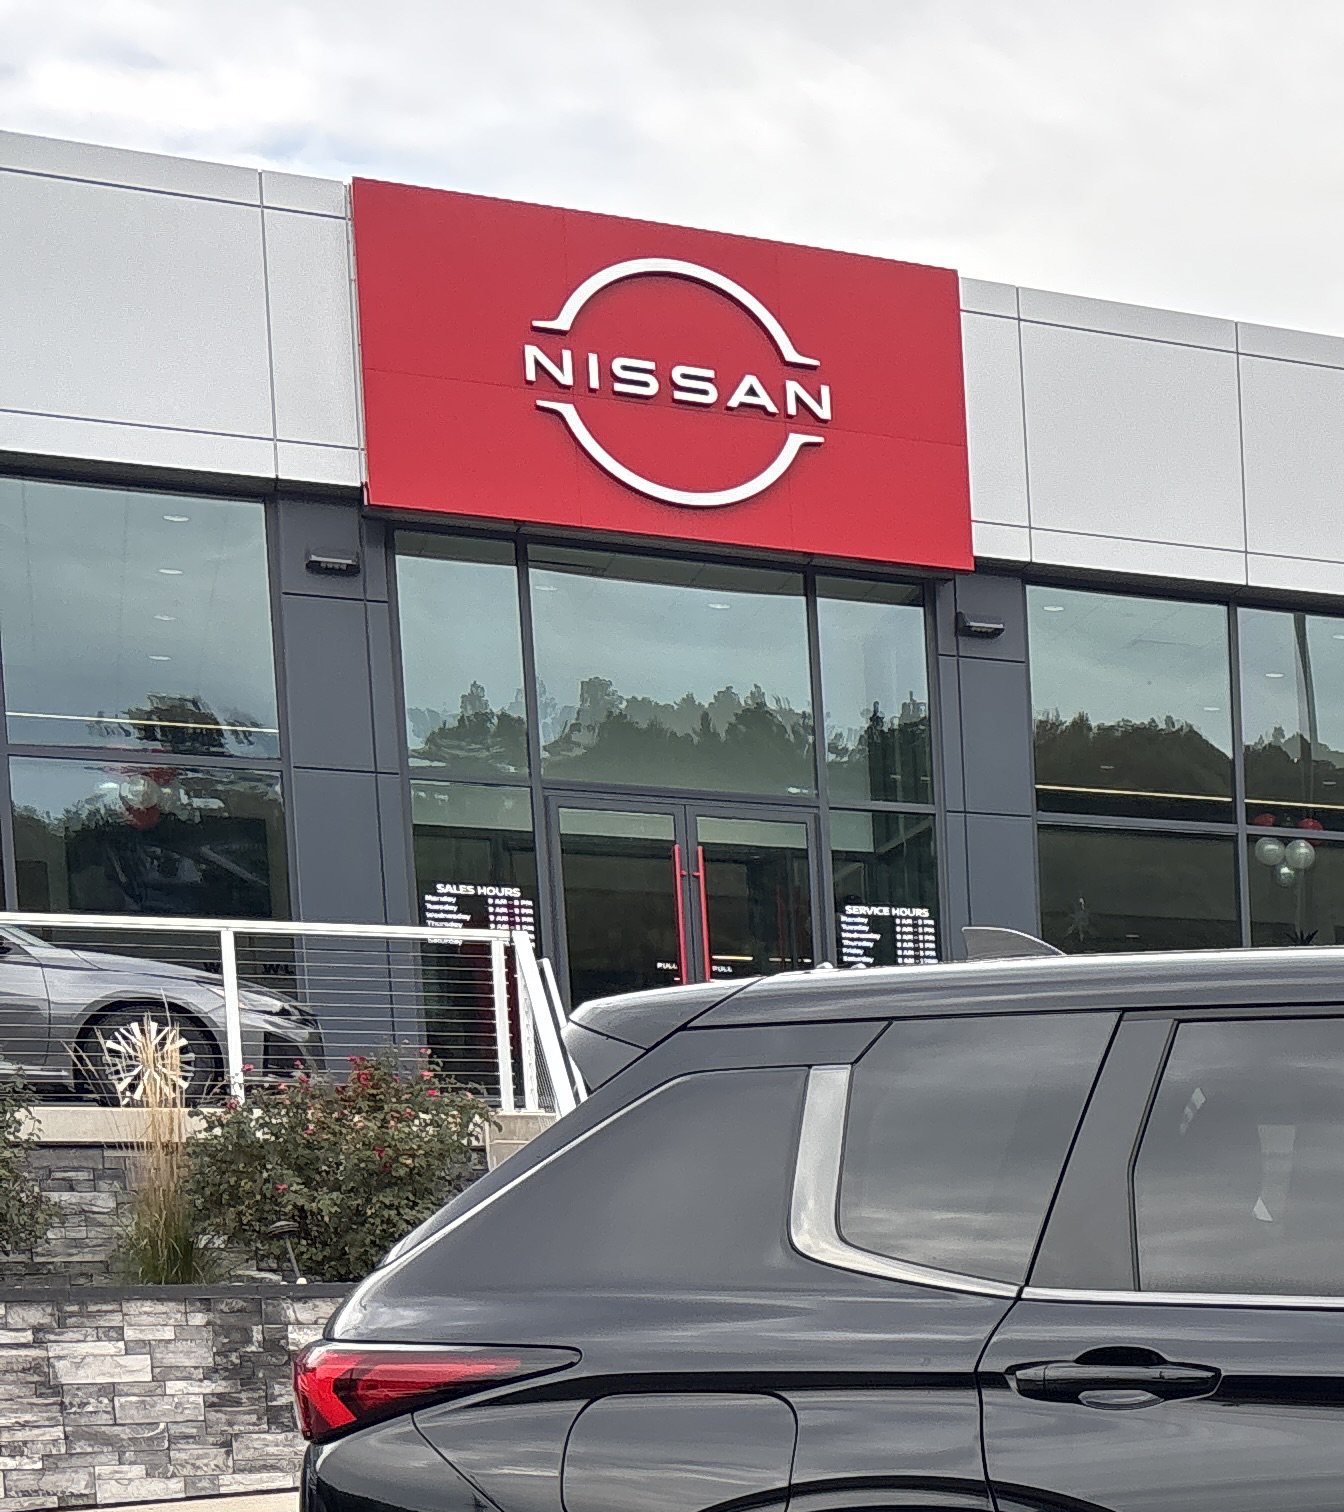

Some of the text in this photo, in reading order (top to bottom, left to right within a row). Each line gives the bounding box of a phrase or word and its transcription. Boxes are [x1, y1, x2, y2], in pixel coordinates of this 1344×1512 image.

[522, 343, 832, 421] NISSAN
[436, 883, 521, 897] SALES HOURS
[845, 905, 929, 917] SERVICE HOURS
